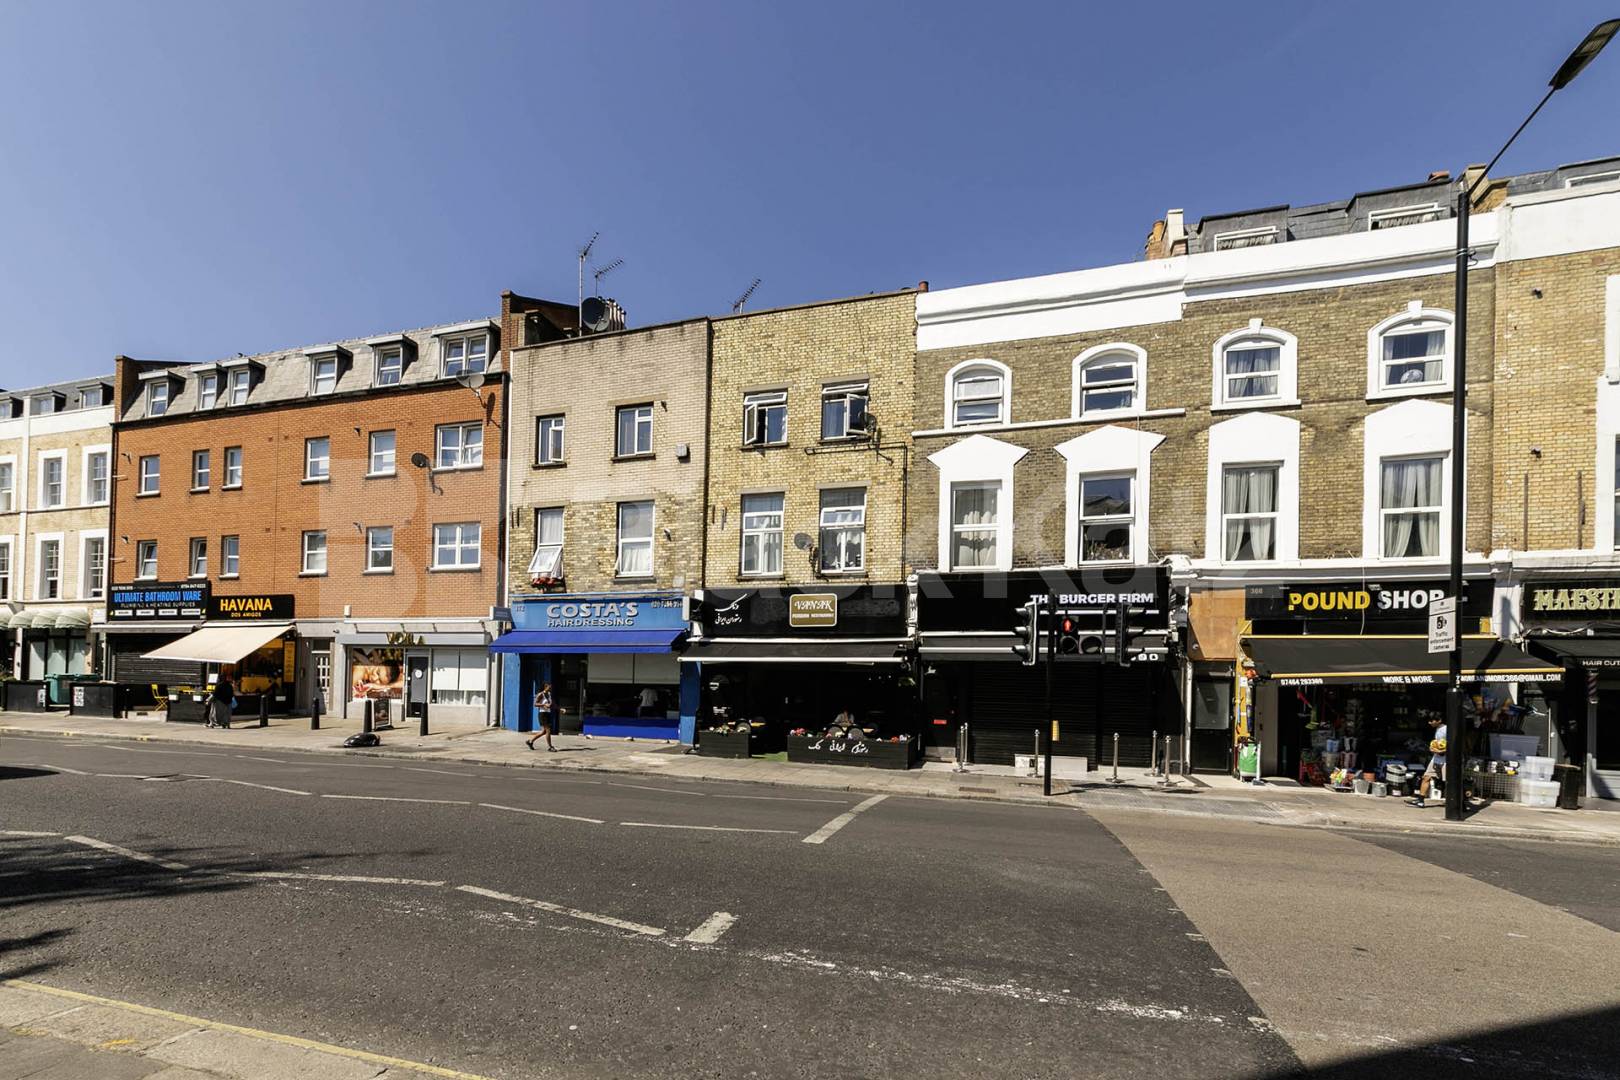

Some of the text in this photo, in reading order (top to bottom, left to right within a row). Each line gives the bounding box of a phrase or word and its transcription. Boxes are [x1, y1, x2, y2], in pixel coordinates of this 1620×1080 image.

[114, 590, 202, 602] ULTIMATE BATHROOM WARE
[1030, 592, 1154, 604] TH BURGER FIRM
[1288, 590, 1371, 611] POUND
[220, 598, 273, 611] HAVANA
[547, 602, 639, 618] COSTA'S
[794, 600, 834, 612] VANAK
[547, 618, 634, 628] HAIRDRESSING
[1382, 675, 1404, 684] MORE
[1411, 675, 1434, 683] MORE
